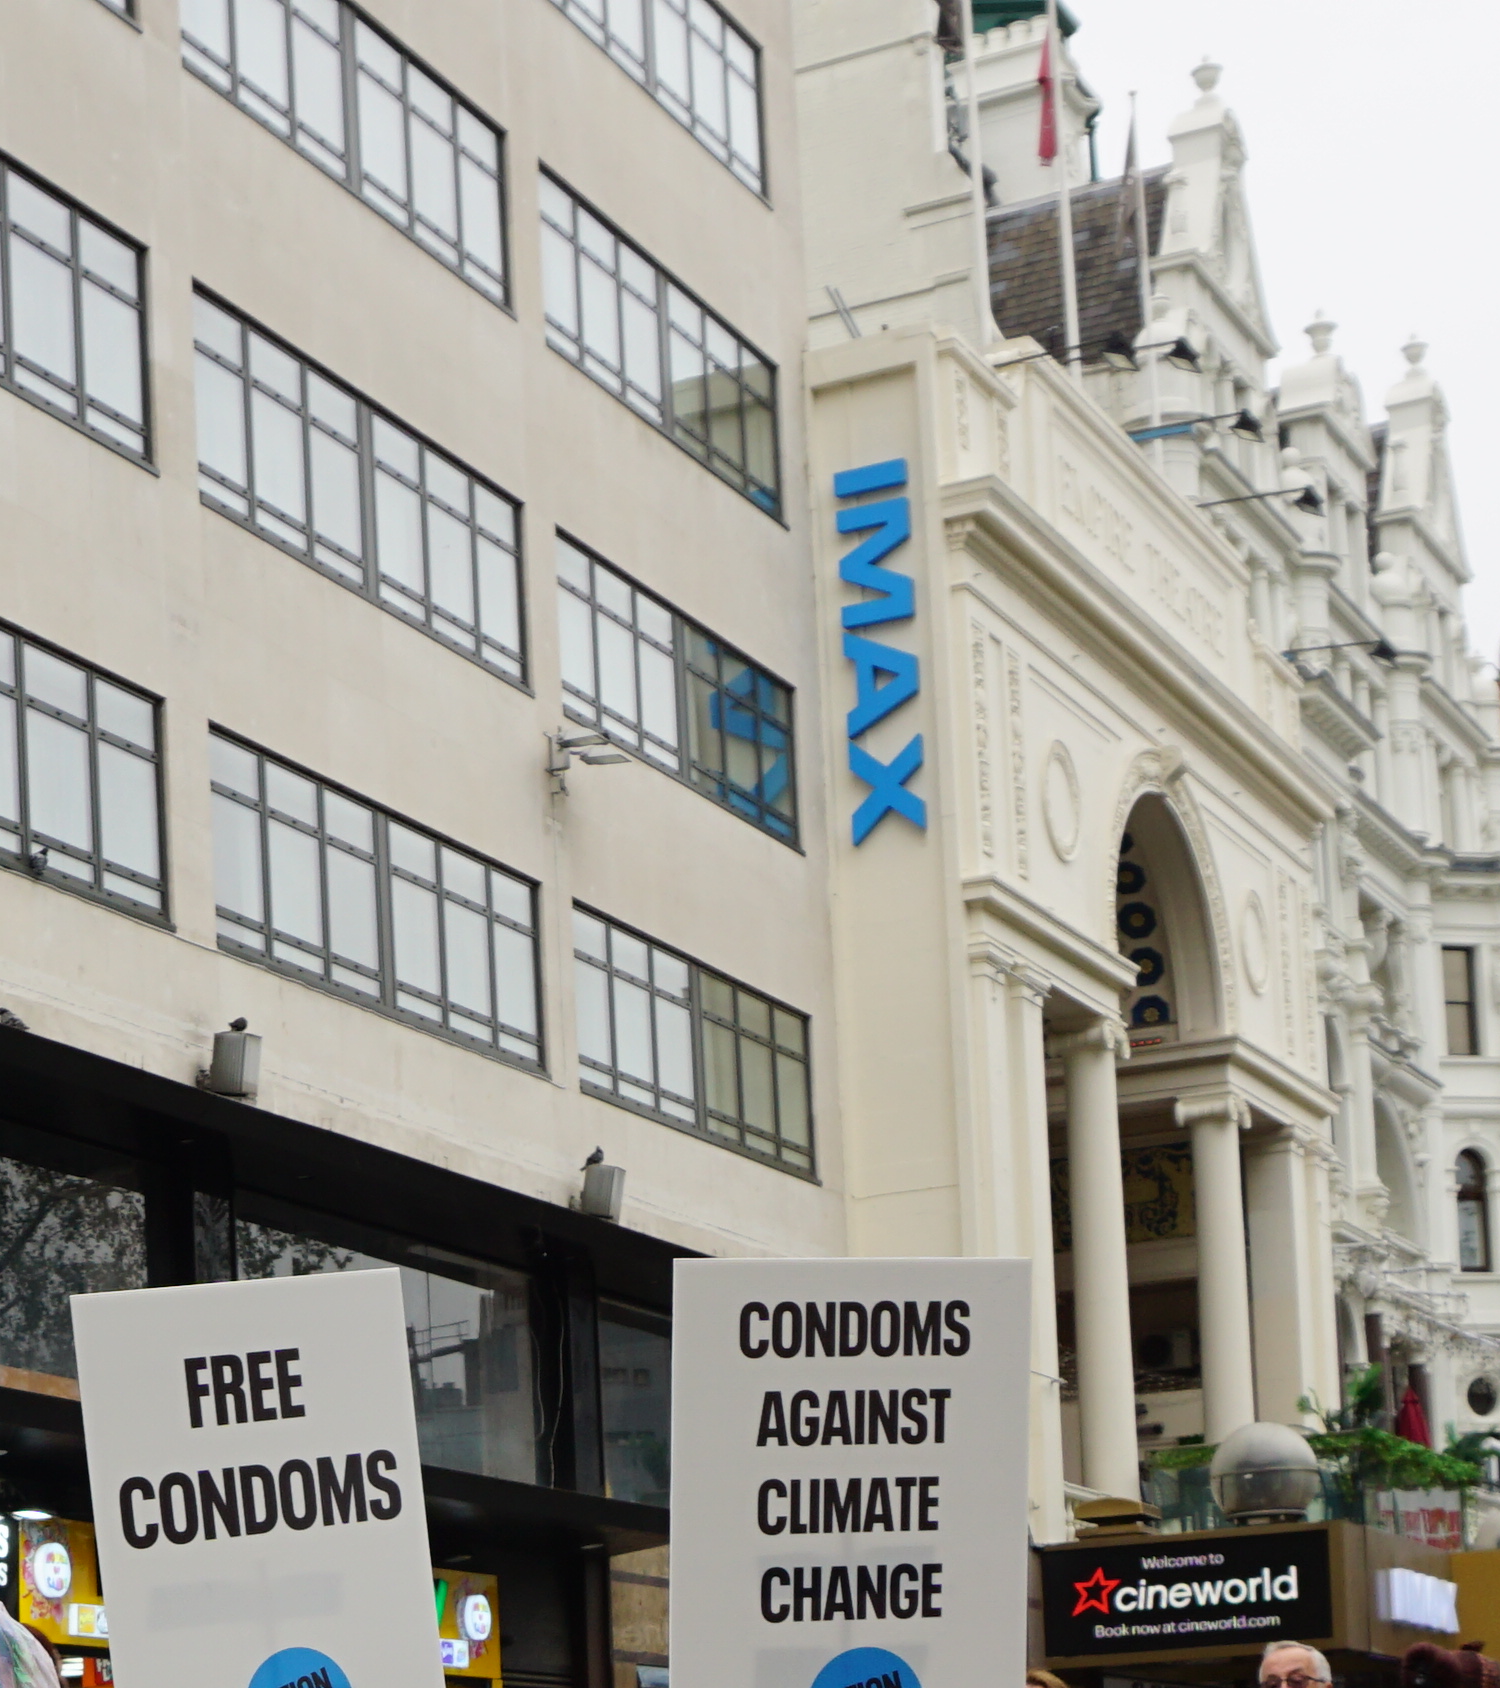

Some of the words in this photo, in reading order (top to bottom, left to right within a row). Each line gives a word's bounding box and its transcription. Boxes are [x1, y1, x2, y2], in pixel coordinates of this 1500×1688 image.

[833, 457, 927, 847] IMAX
[739, 1299, 971, 1359] CONDOMS
[183, 1347, 306, 1430] FREE
[755, 1388, 952, 1447] AGAINST
[118, 1448, 403, 1550] CONDOMS
[757, 1476, 939, 1536] CLIMATE
[1114, 1565, 1299, 1613] cineworld
[1141, 1555, 1206, 1570] Welcome
[1209, 1552, 1225, 1566] to
[760, 1563, 943, 1624] CHANGE
[1094, 1622, 1129, 1639] Book
[1131, 1623, 1161, 1636] now
[1162, 1619, 1176, 1634] at
[1178, 1614, 1281, 1634] cineworld.com
